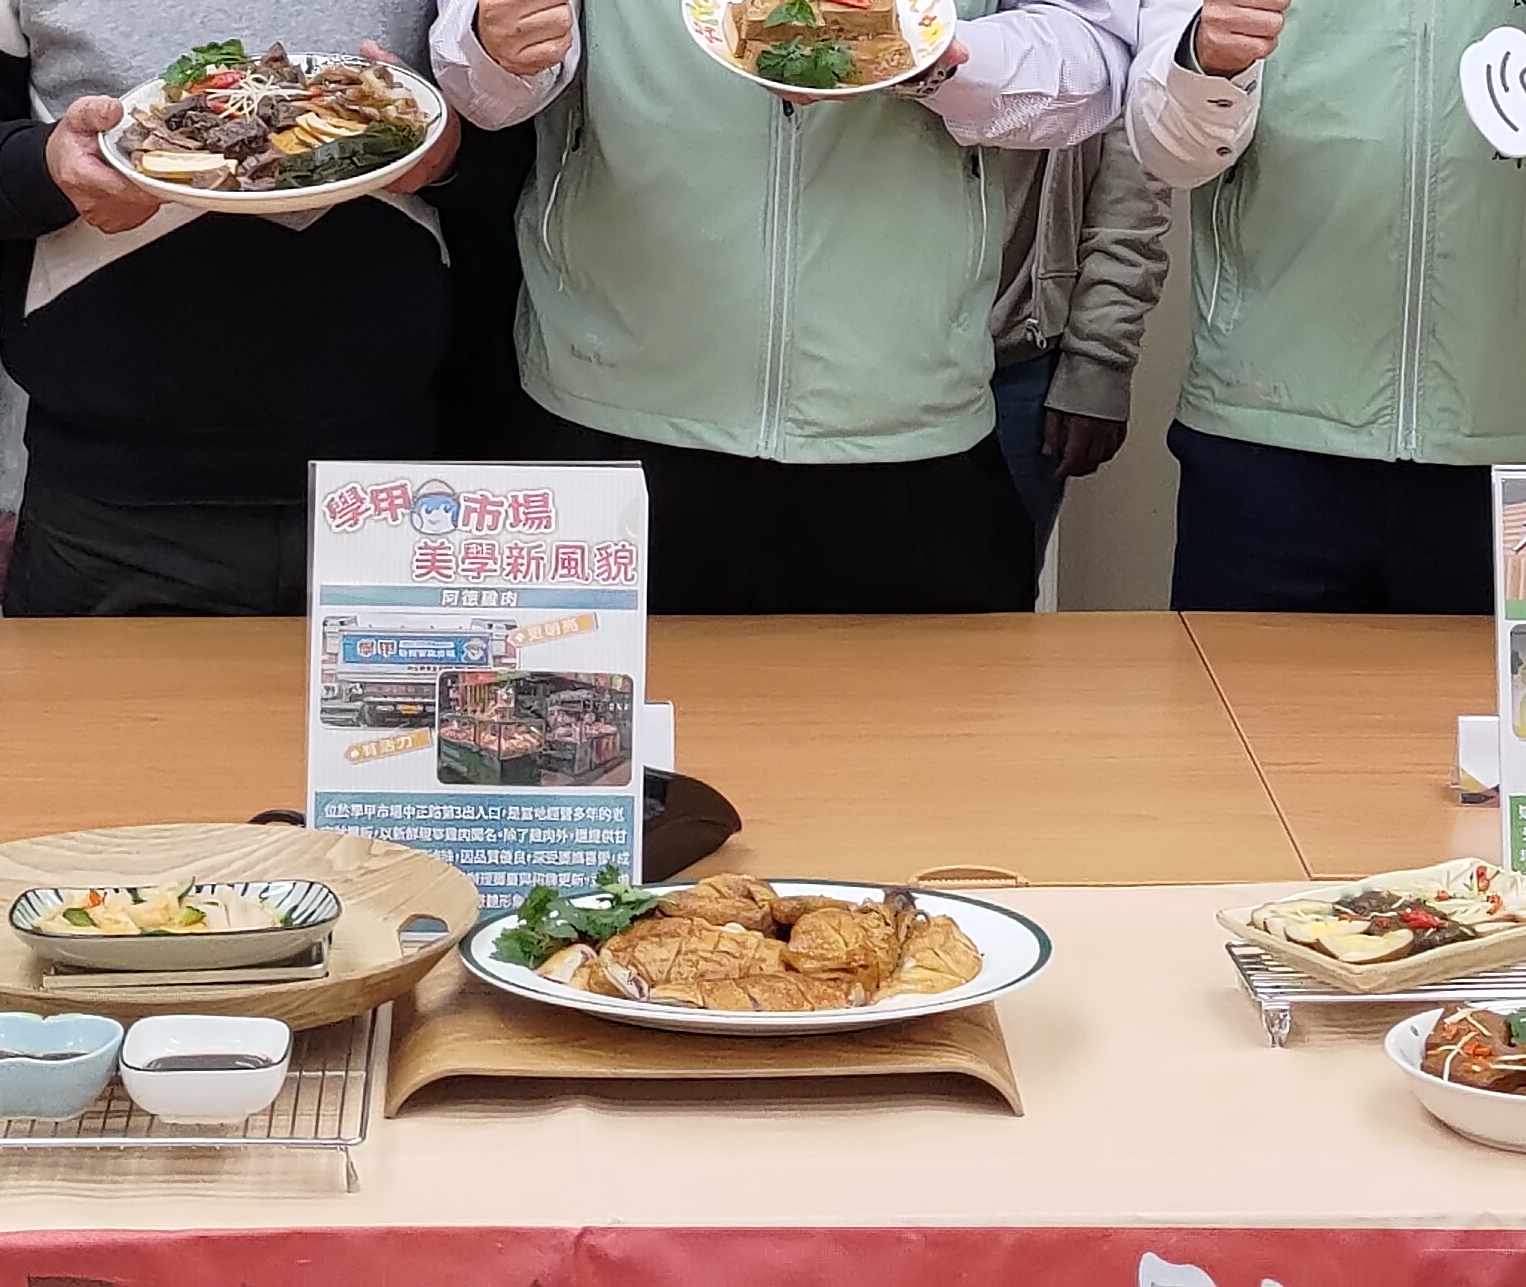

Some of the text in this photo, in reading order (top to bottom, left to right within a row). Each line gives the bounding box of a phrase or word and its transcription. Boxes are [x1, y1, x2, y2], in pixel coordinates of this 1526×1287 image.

[326, 482, 554, 533] 學甲 市場
[414, 542, 636, 583] 美學新風貌
